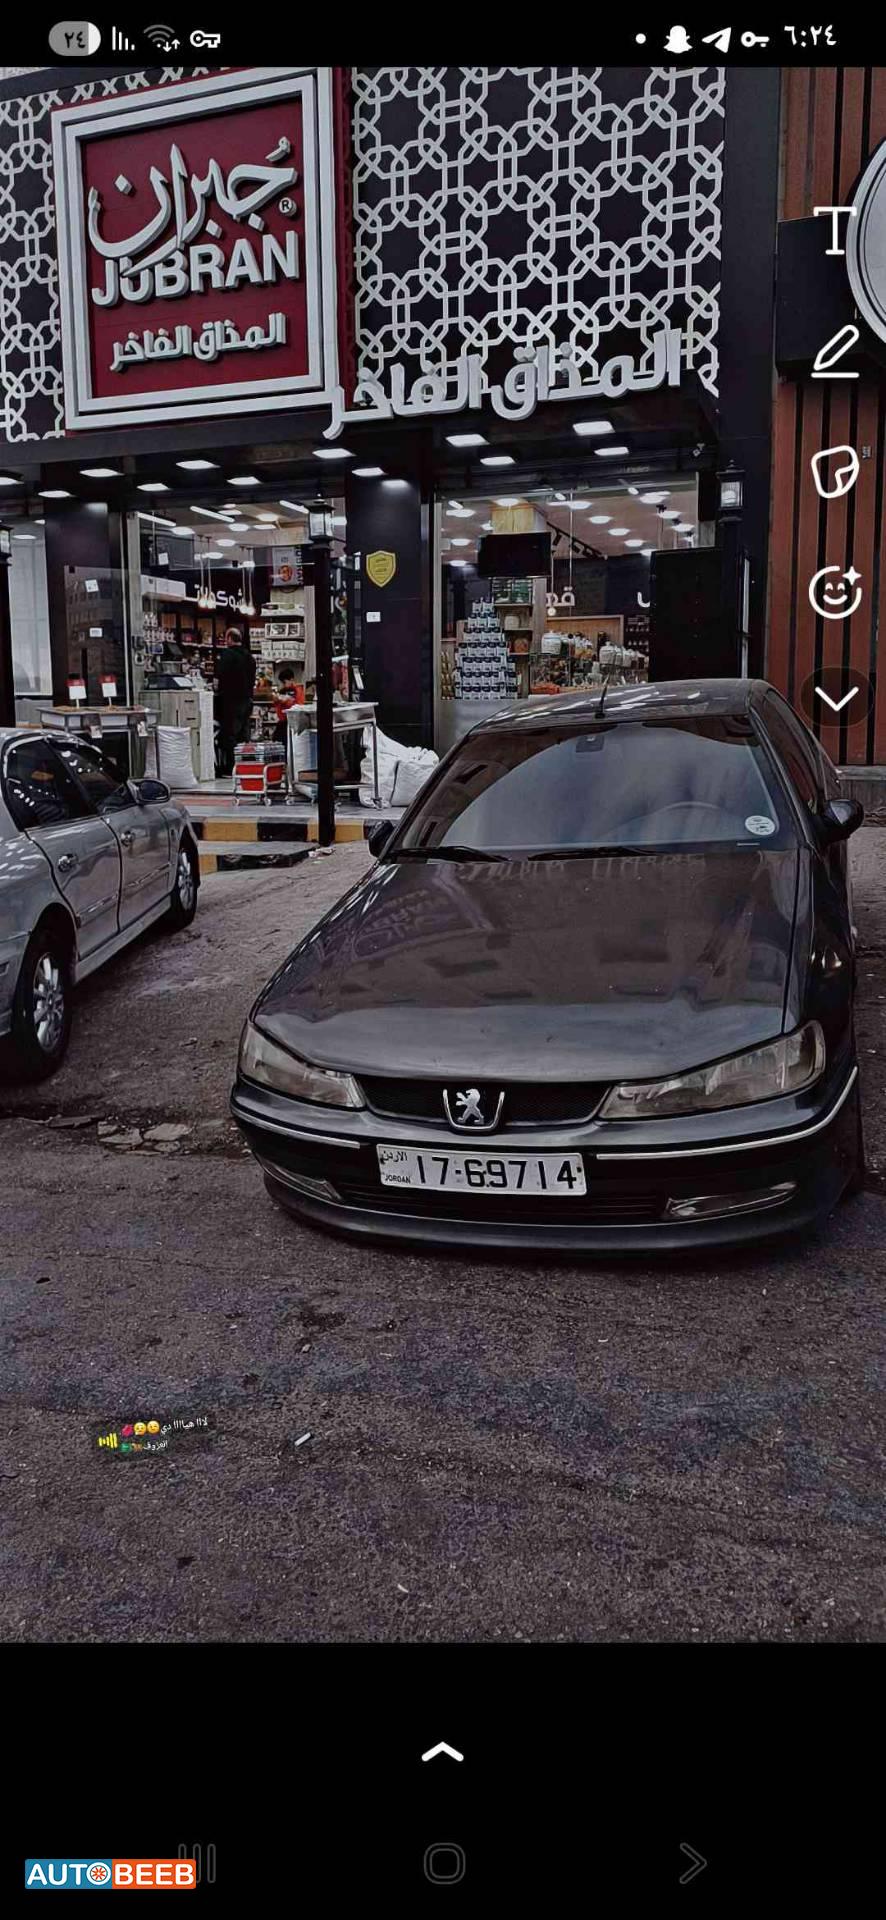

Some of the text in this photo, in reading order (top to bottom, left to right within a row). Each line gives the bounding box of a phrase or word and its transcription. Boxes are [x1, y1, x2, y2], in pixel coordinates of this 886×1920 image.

[91, 230, 299, 306] JUBRAN
[109, 312, 287, 373] المذاق الفاخر
[321, 327, 682, 440] المذاق الفاخر
[384, 1173, 411, 1184] JORDAN
